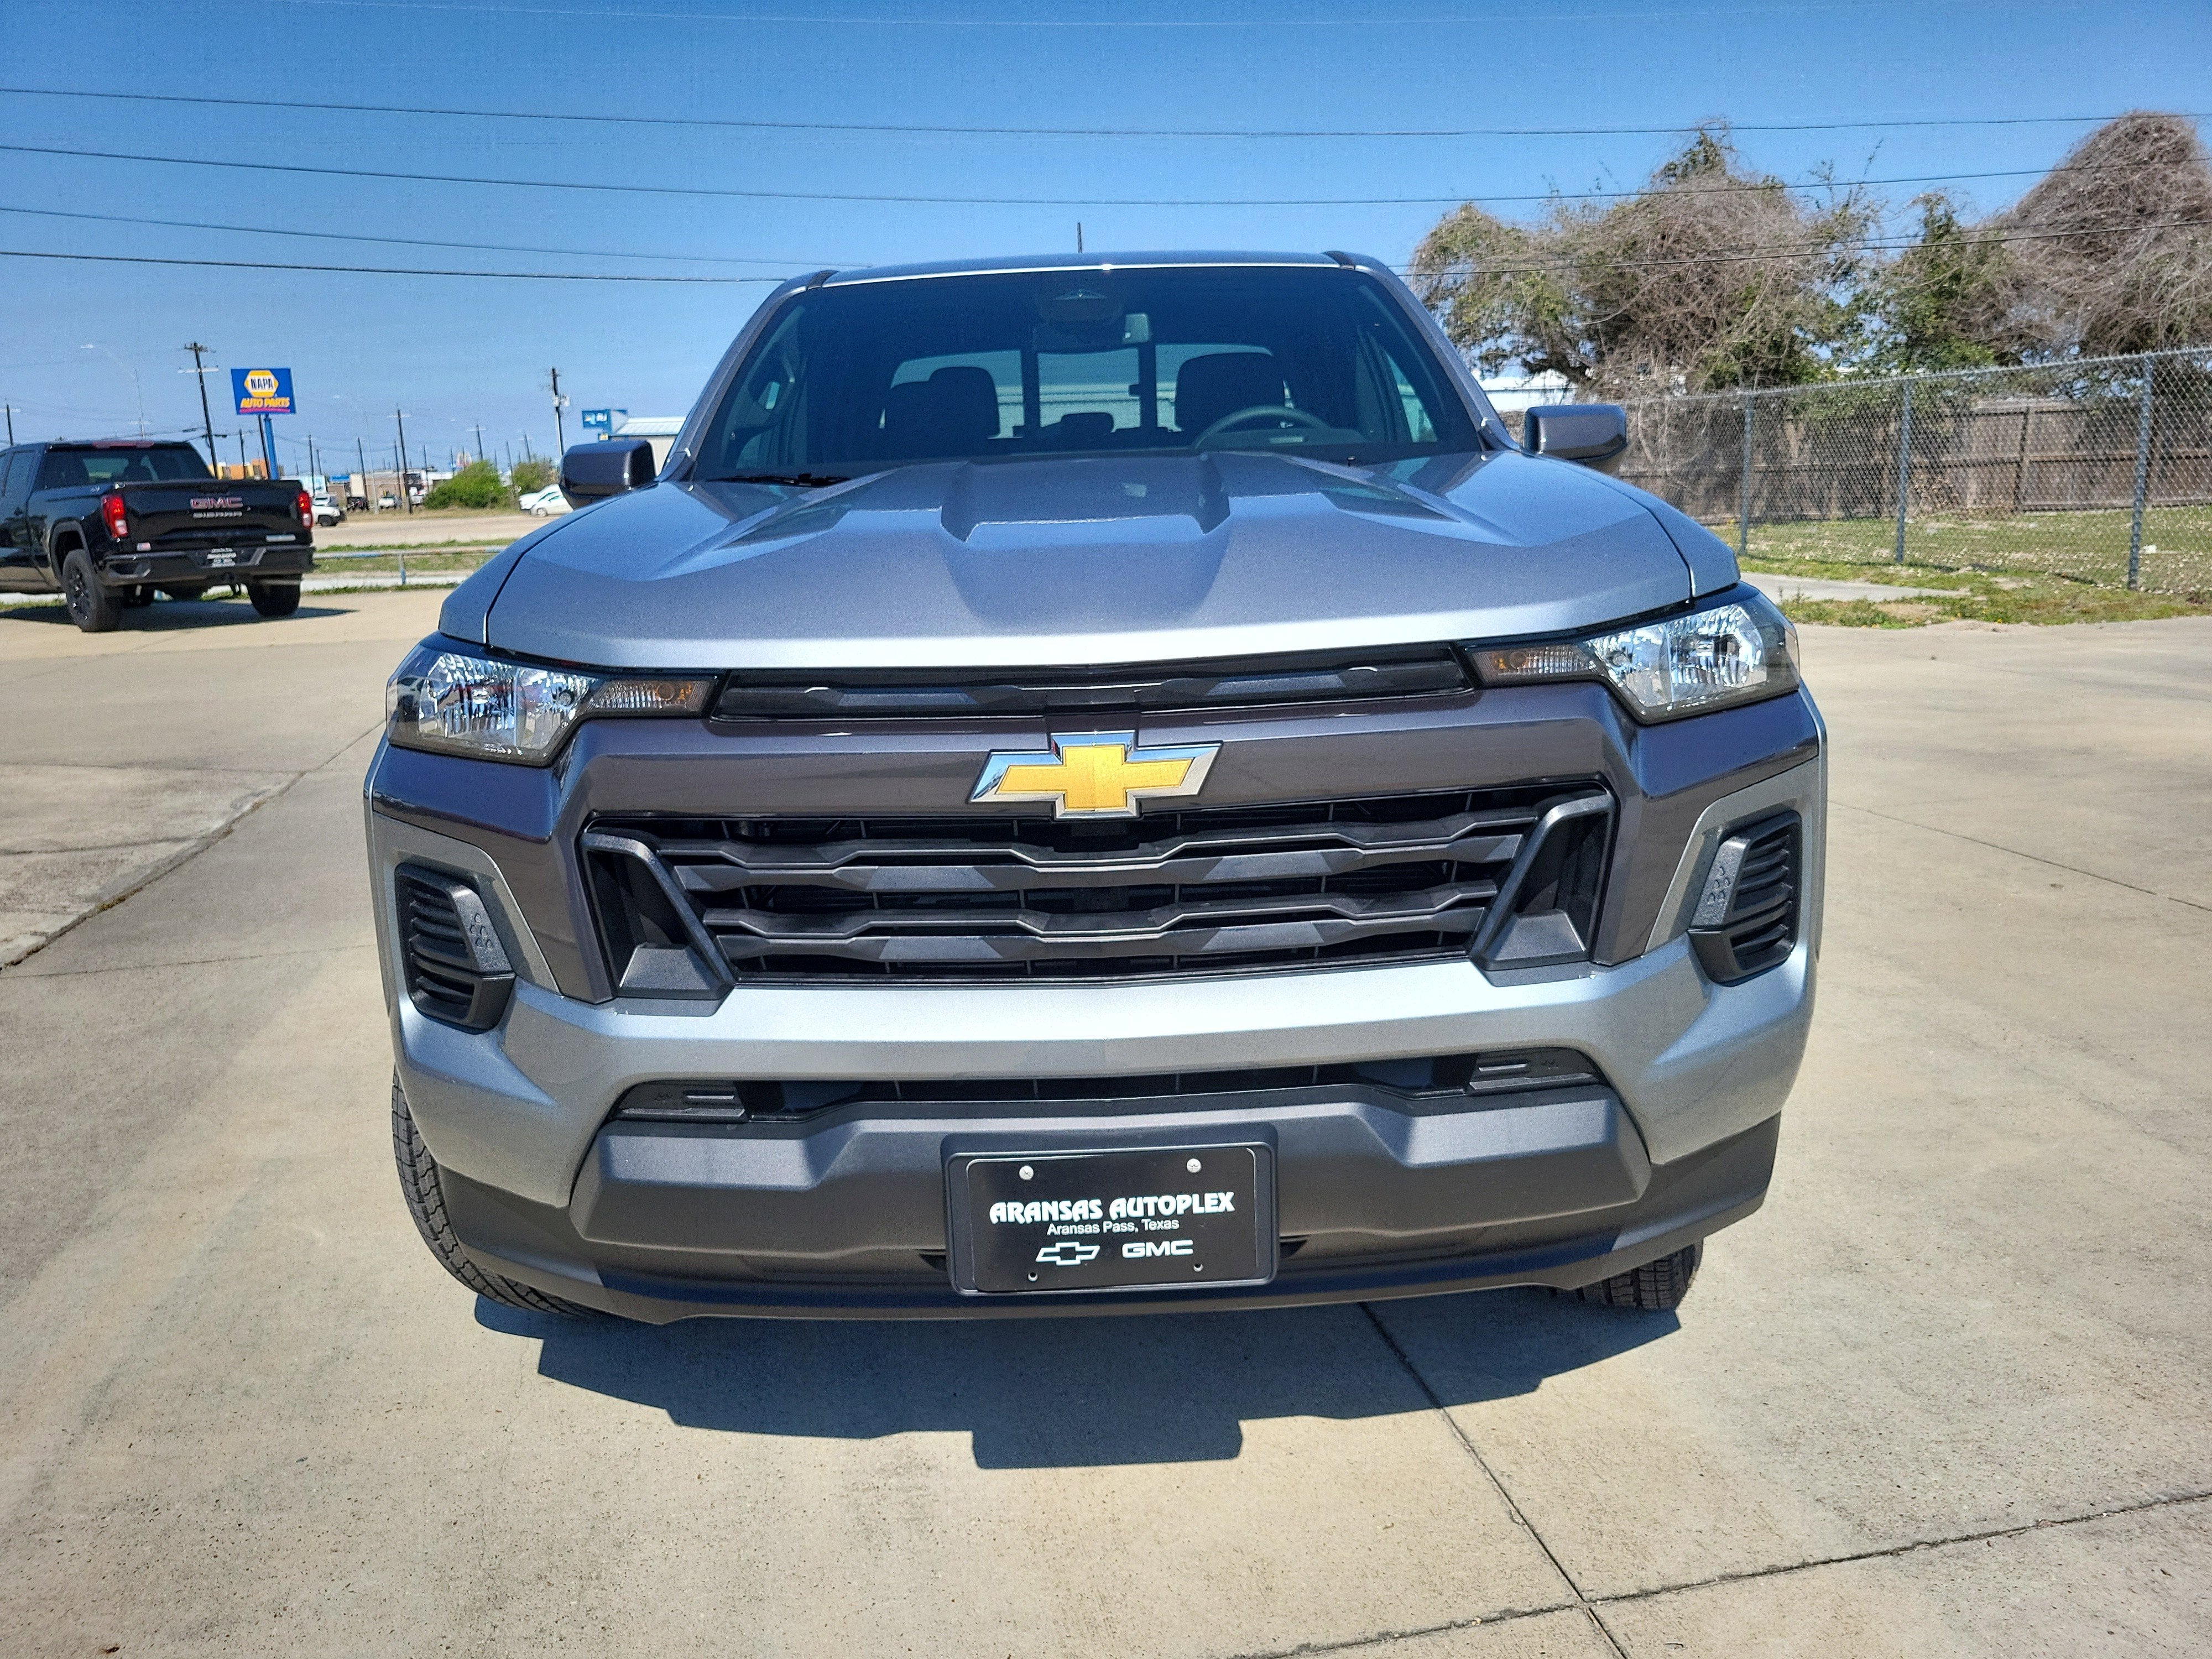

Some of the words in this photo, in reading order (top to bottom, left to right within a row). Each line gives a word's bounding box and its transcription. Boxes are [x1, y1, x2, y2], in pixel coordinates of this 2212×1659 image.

[251, 378, 273, 389] NAPA
[241, 398, 263, 408] AUTO
[264, 397, 290, 408] PARTS
[190, 497, 243, 509] GMC
[989, 1199, 1103, 1224] ARANSAS
[1109, 1191, 1235, 1220] AUTOPLEX
[1046, 1223, 1100, 1236] Aransas
[1103, 1220, 1139, 1234] Pass,
[1141, 1218, 1180, 1231] Texas
[1121, 1239, 1194, 1258] GMC
